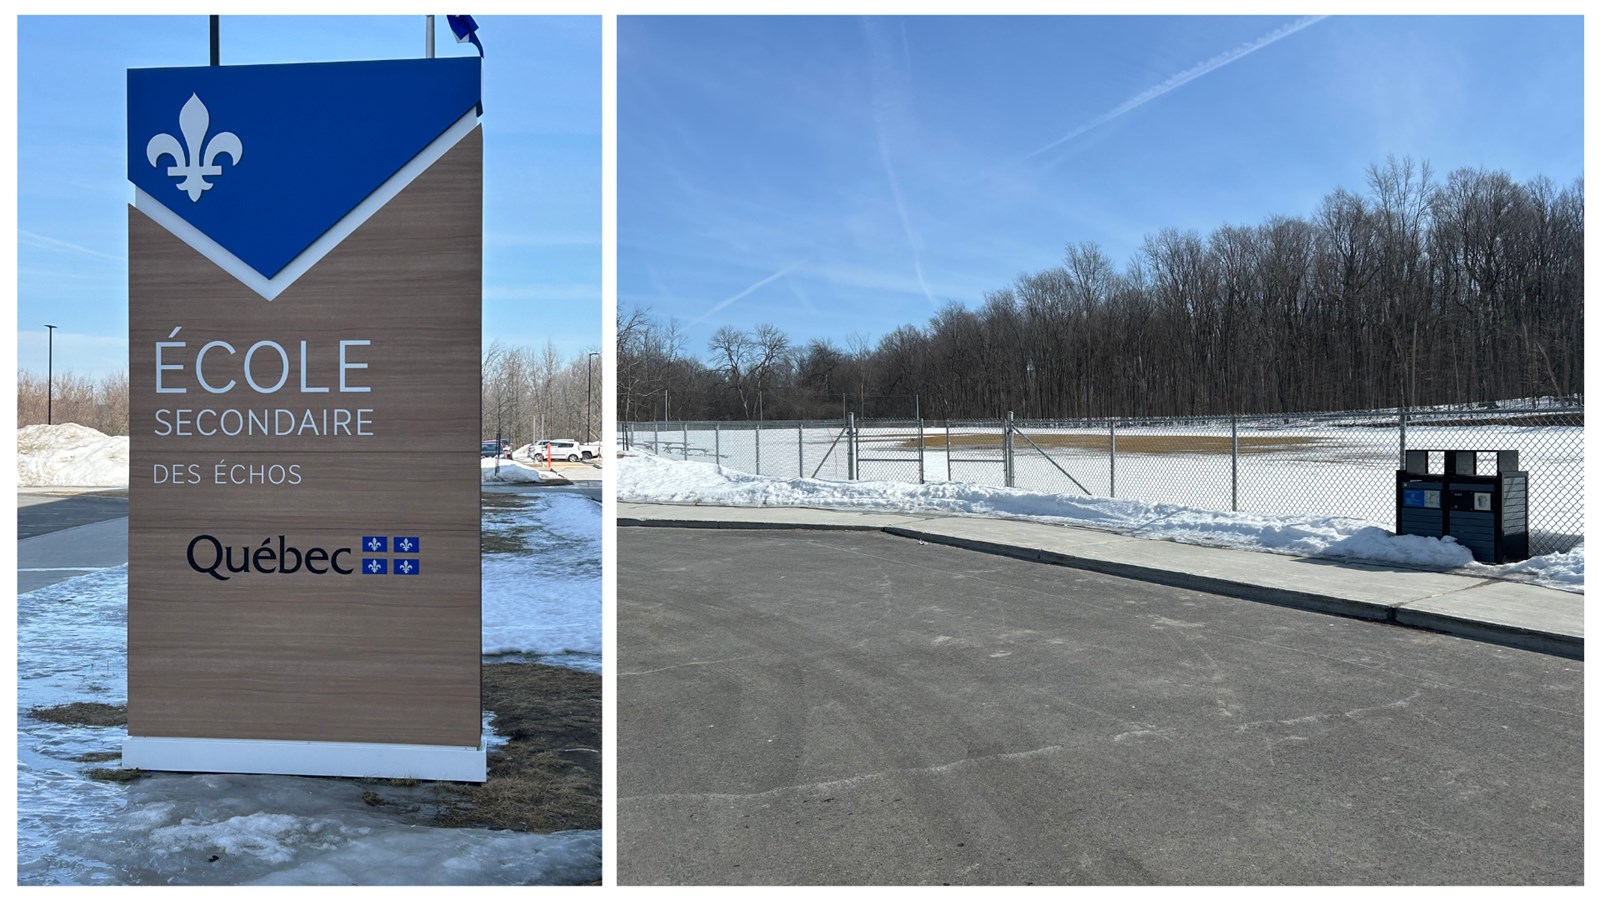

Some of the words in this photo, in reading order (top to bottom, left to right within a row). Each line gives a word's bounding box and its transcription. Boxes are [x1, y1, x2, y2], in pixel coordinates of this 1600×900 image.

[155, 326, 371, 393] ÉCOLE
[154, 408, 374, 436] SECONDAIRE
[153, 464, 201, 484] DES
[215, 459, 302, 485] ÉCHOS
[187, 534, 354, 580] Québec
